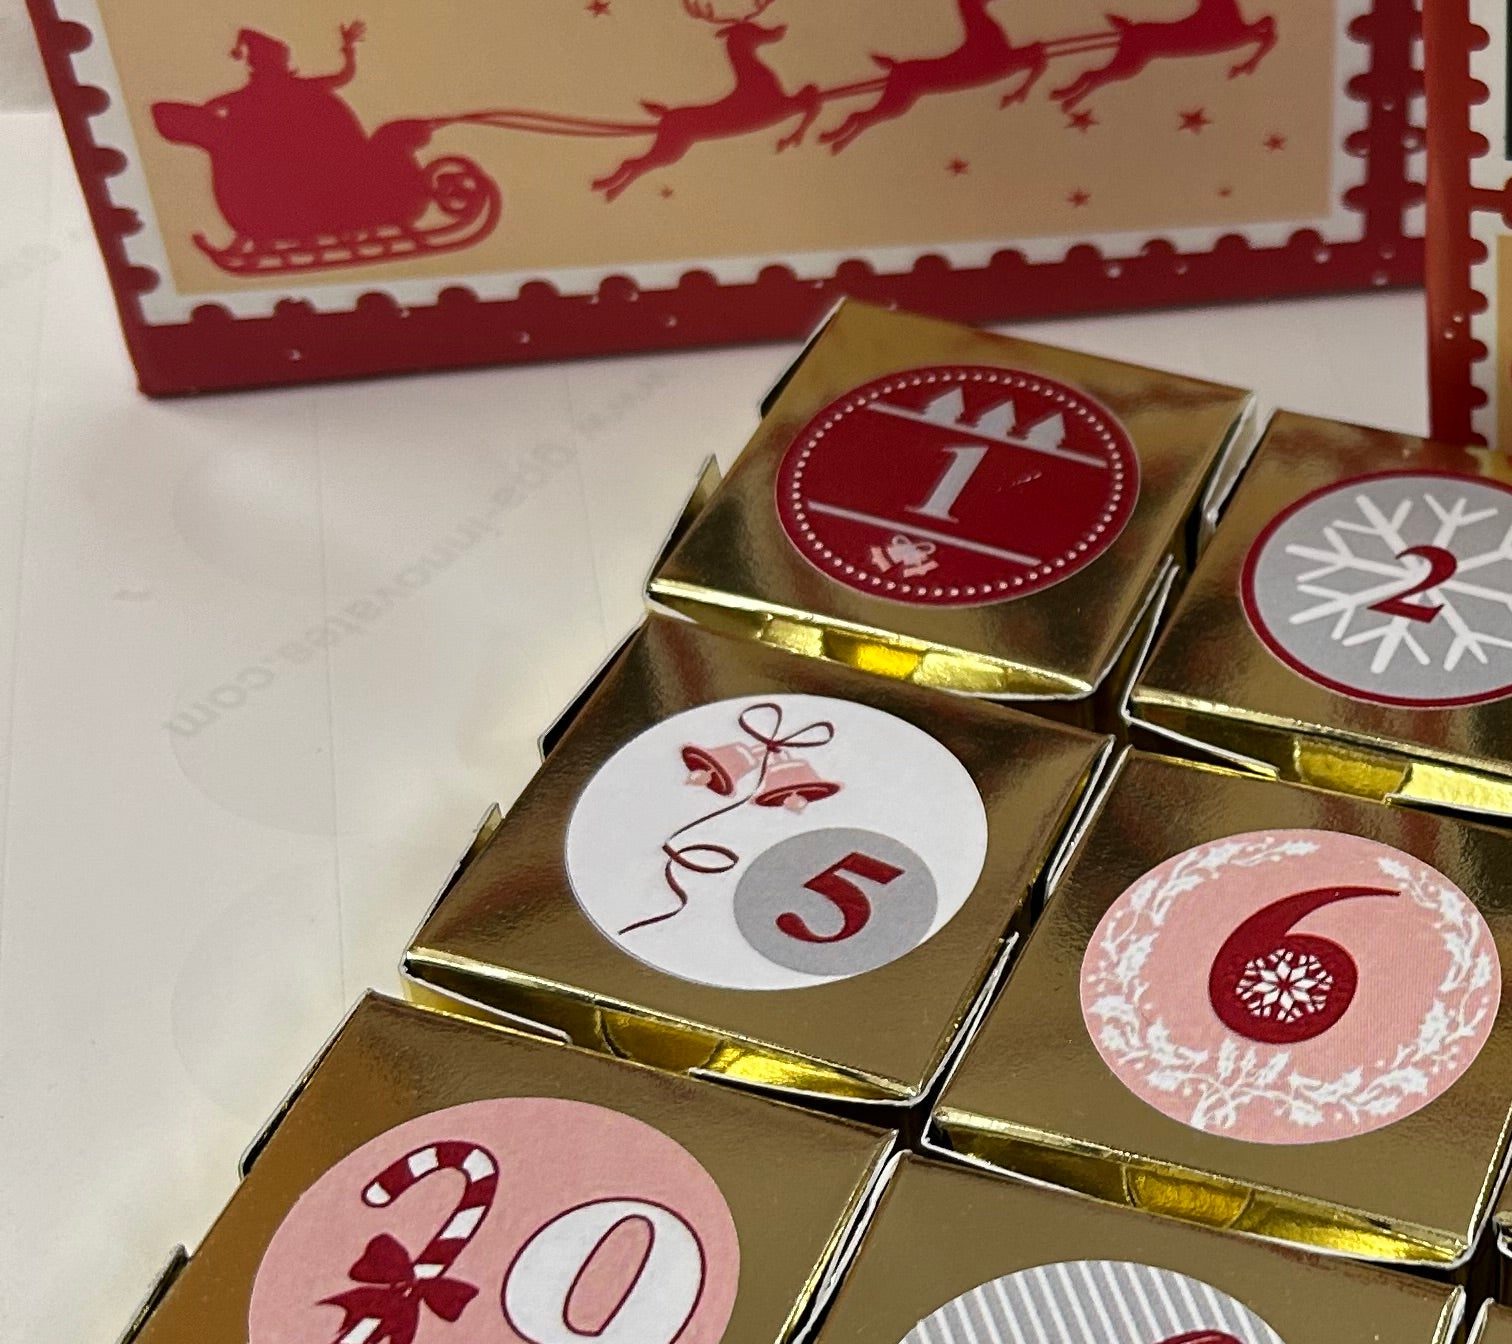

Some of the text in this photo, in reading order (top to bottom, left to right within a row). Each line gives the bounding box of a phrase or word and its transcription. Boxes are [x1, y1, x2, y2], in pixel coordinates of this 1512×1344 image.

[906, 442, 970, 523] 1
[1366, 543, 1460, 624] 2
[773, 848, 907, 944] 5
[1207, 885, 1403, 1045] 6
